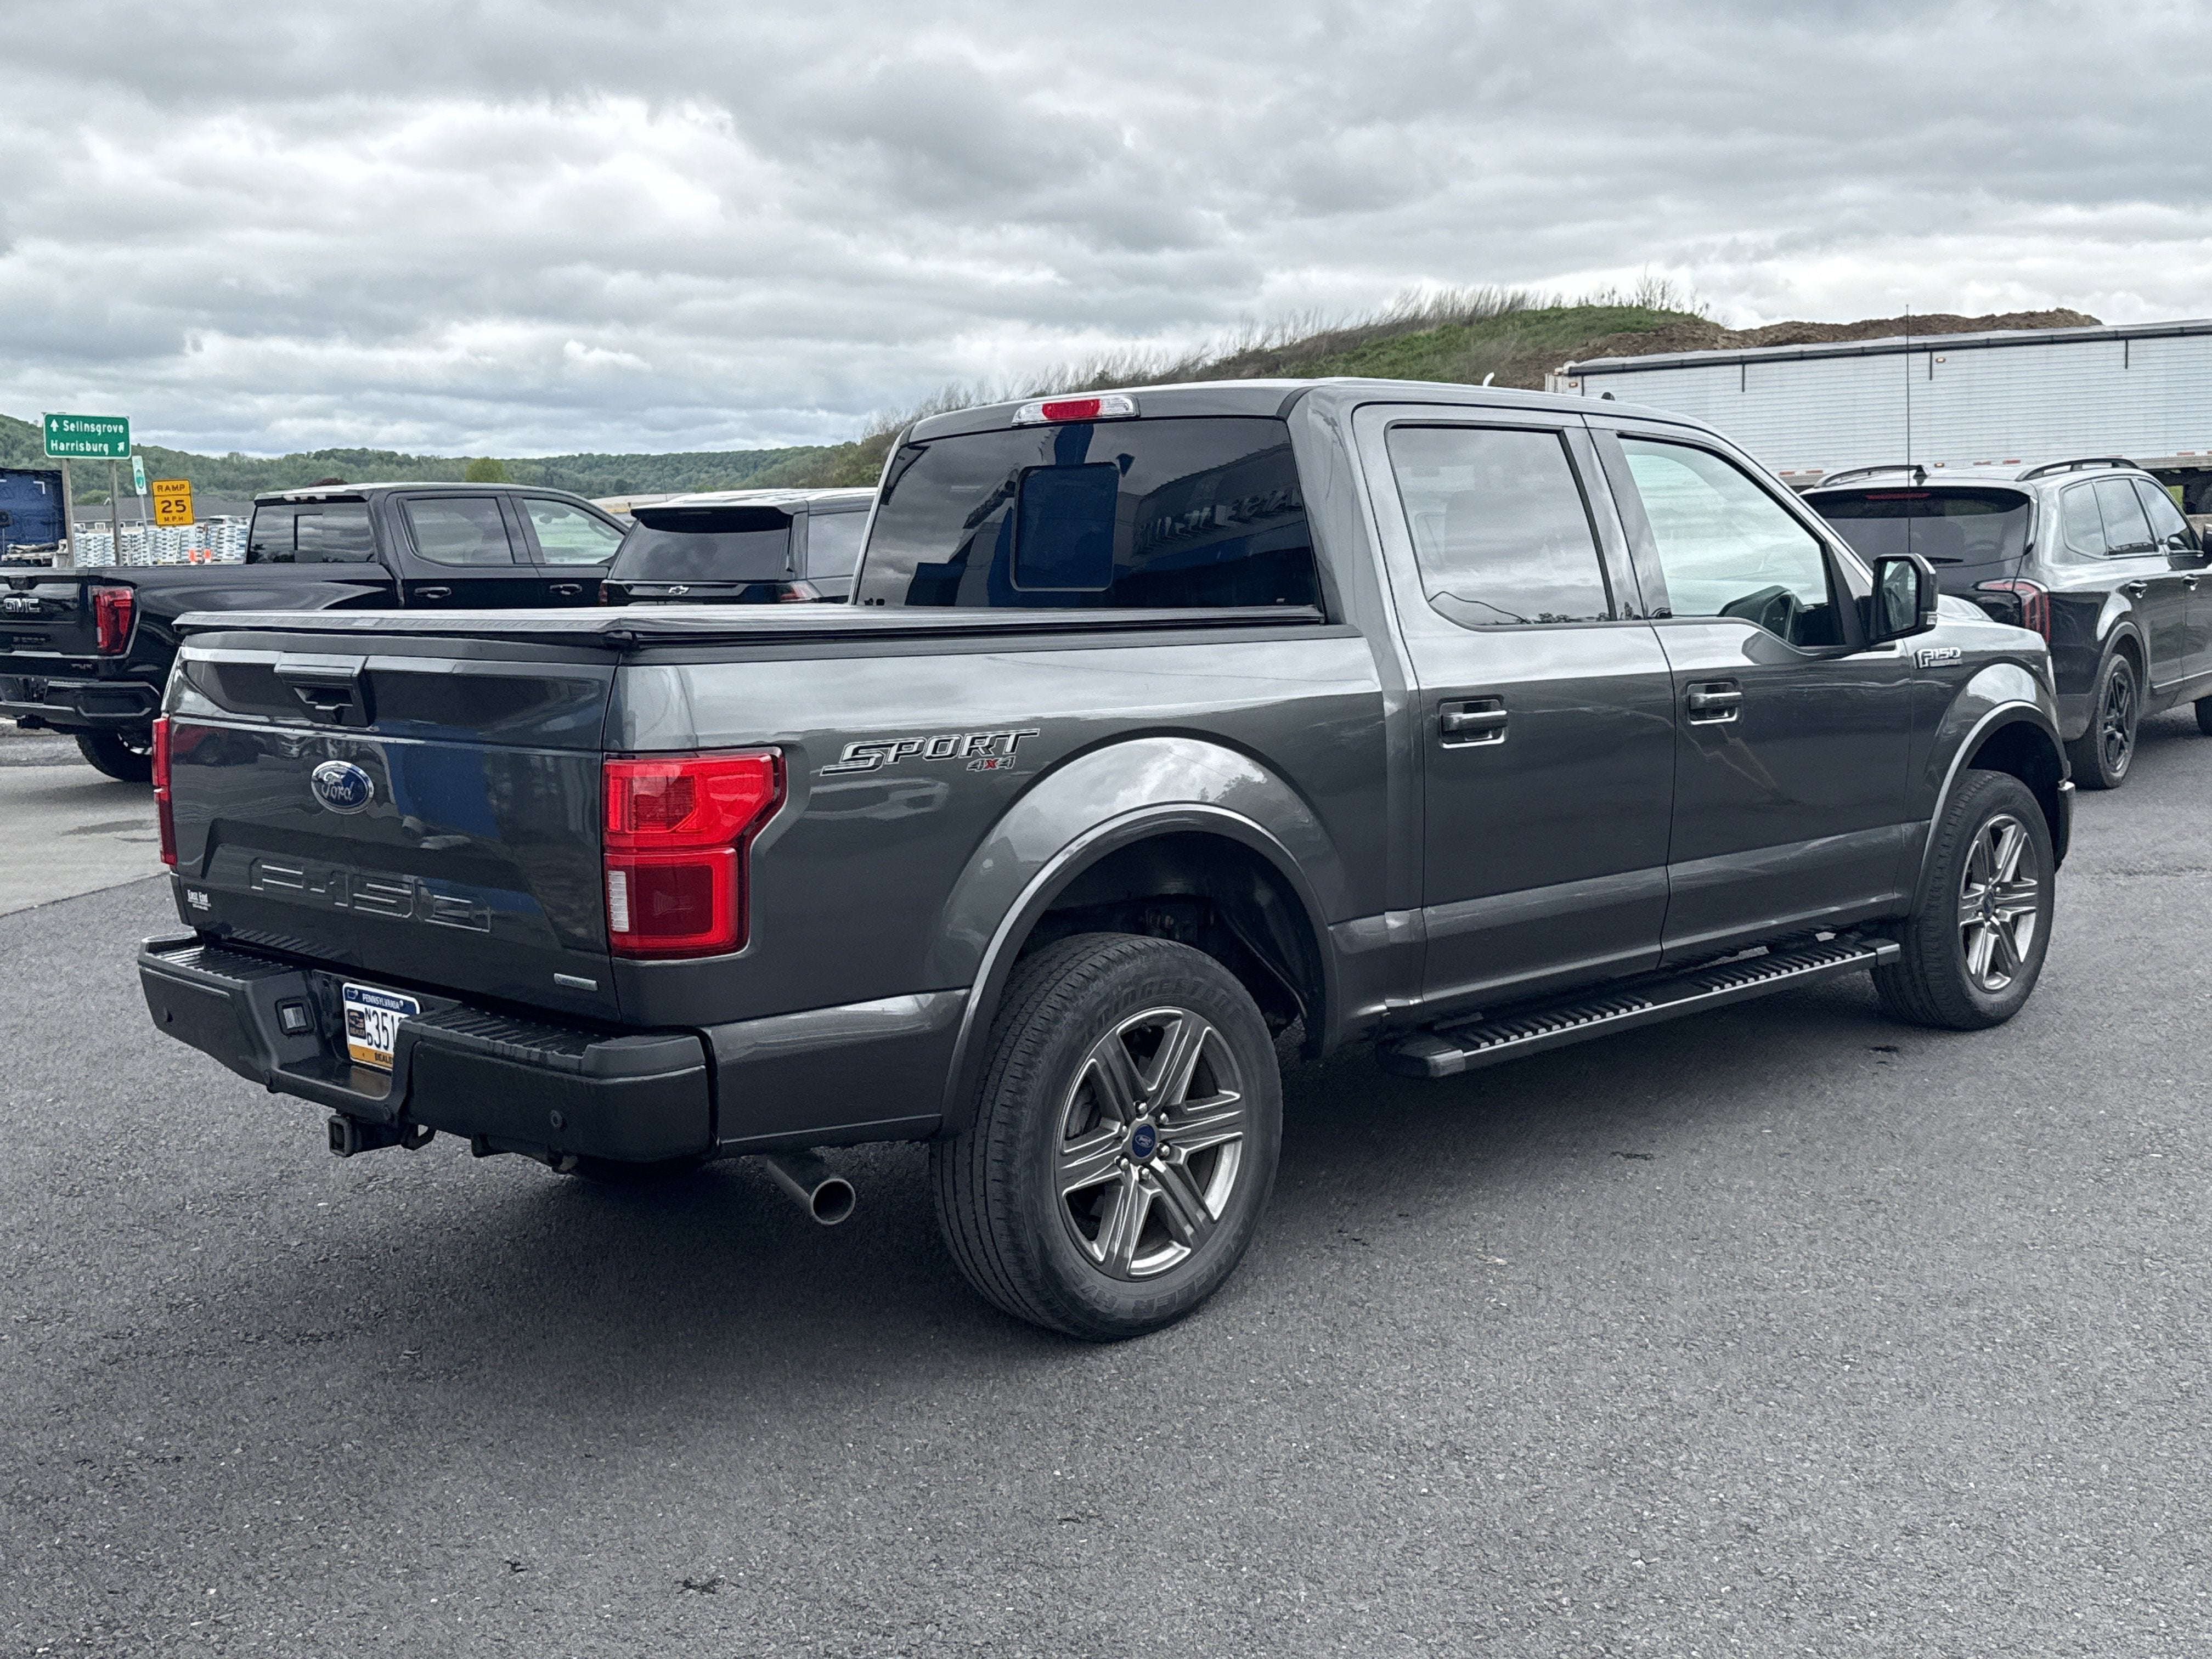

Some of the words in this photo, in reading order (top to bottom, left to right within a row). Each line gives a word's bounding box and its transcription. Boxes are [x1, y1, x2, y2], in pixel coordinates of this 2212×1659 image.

[63, 420, 124, 436] Selinsgrove
[50, 439, 109, 455] Harrisburg
[157, 484, 185, 492] RAMP
[161, 500, 187, 514] 25
[4, 597, 41, 613] GMC
[820, 728, 1040, 777] SPORT
[321, 771, 355, 801] Ford
